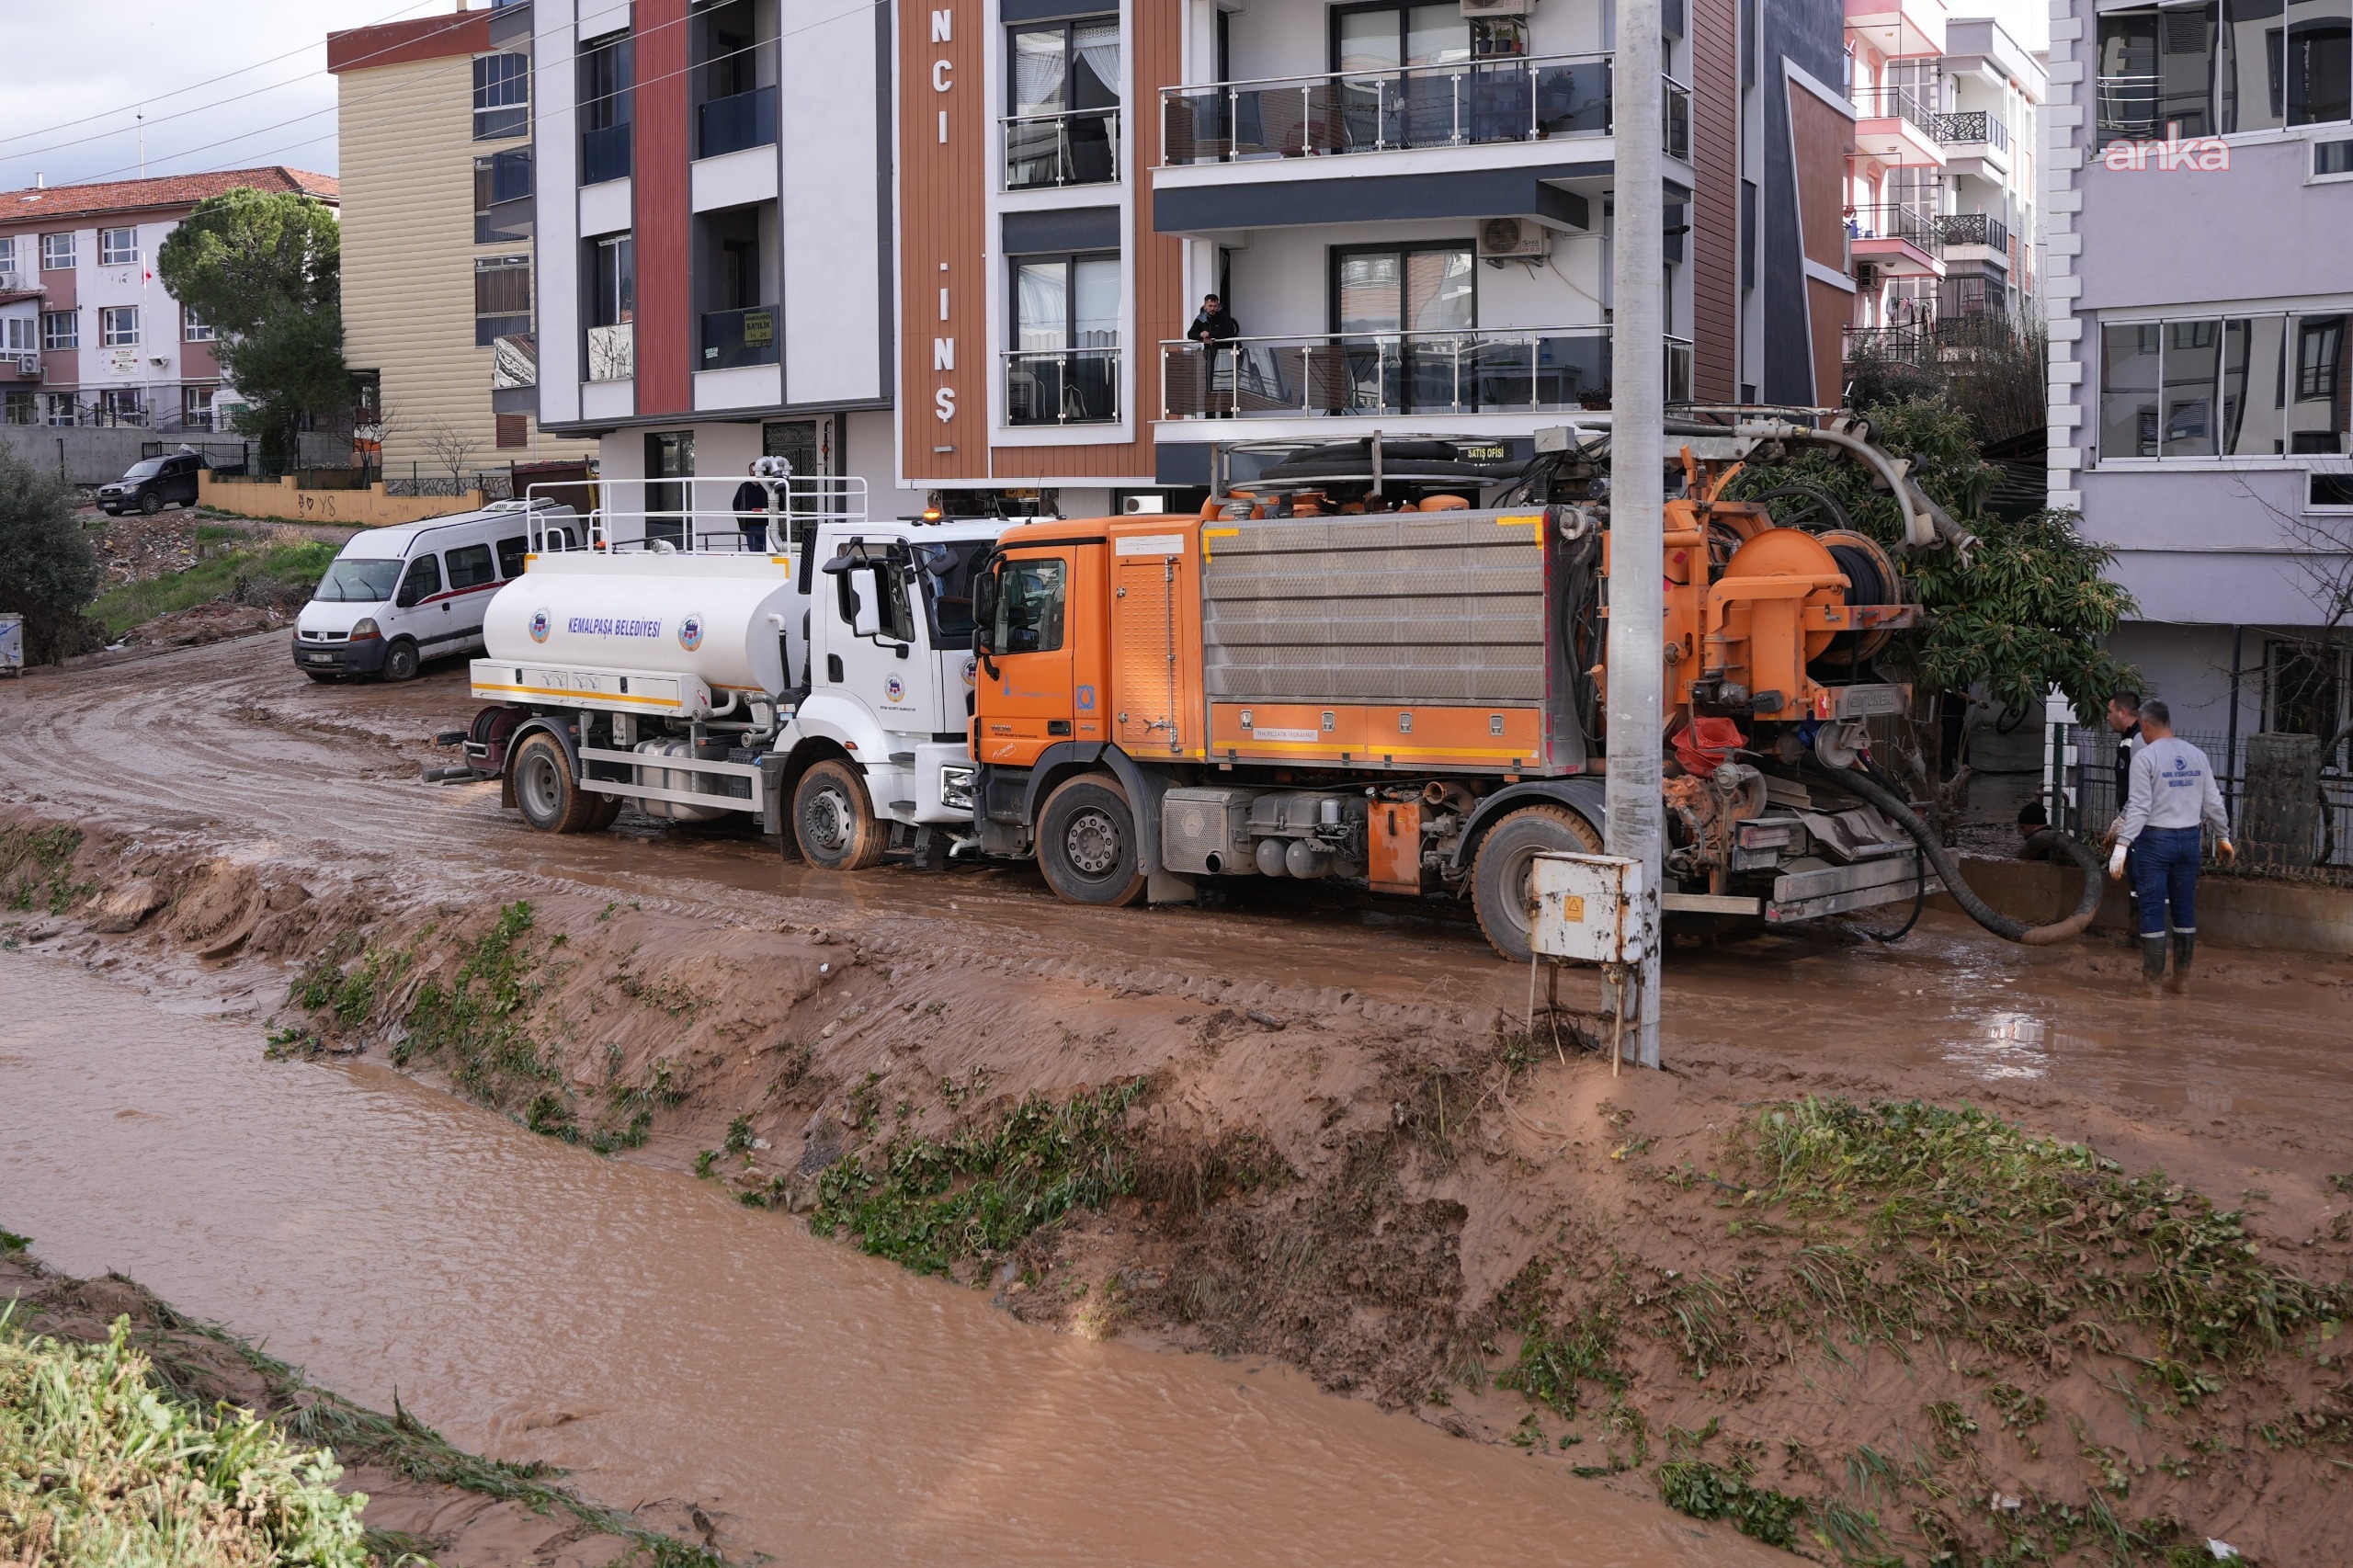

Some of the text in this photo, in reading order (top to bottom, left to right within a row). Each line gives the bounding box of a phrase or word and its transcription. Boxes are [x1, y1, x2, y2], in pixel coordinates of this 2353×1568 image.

[746, 322, 770, 331] SATILIK
[1468, 446, 1504, 460] SATIŞ OFİSİ
[568, 618, 613, 639] KEMALPAŞA
[615, 617, 662, 638] BELEDİYESİ
